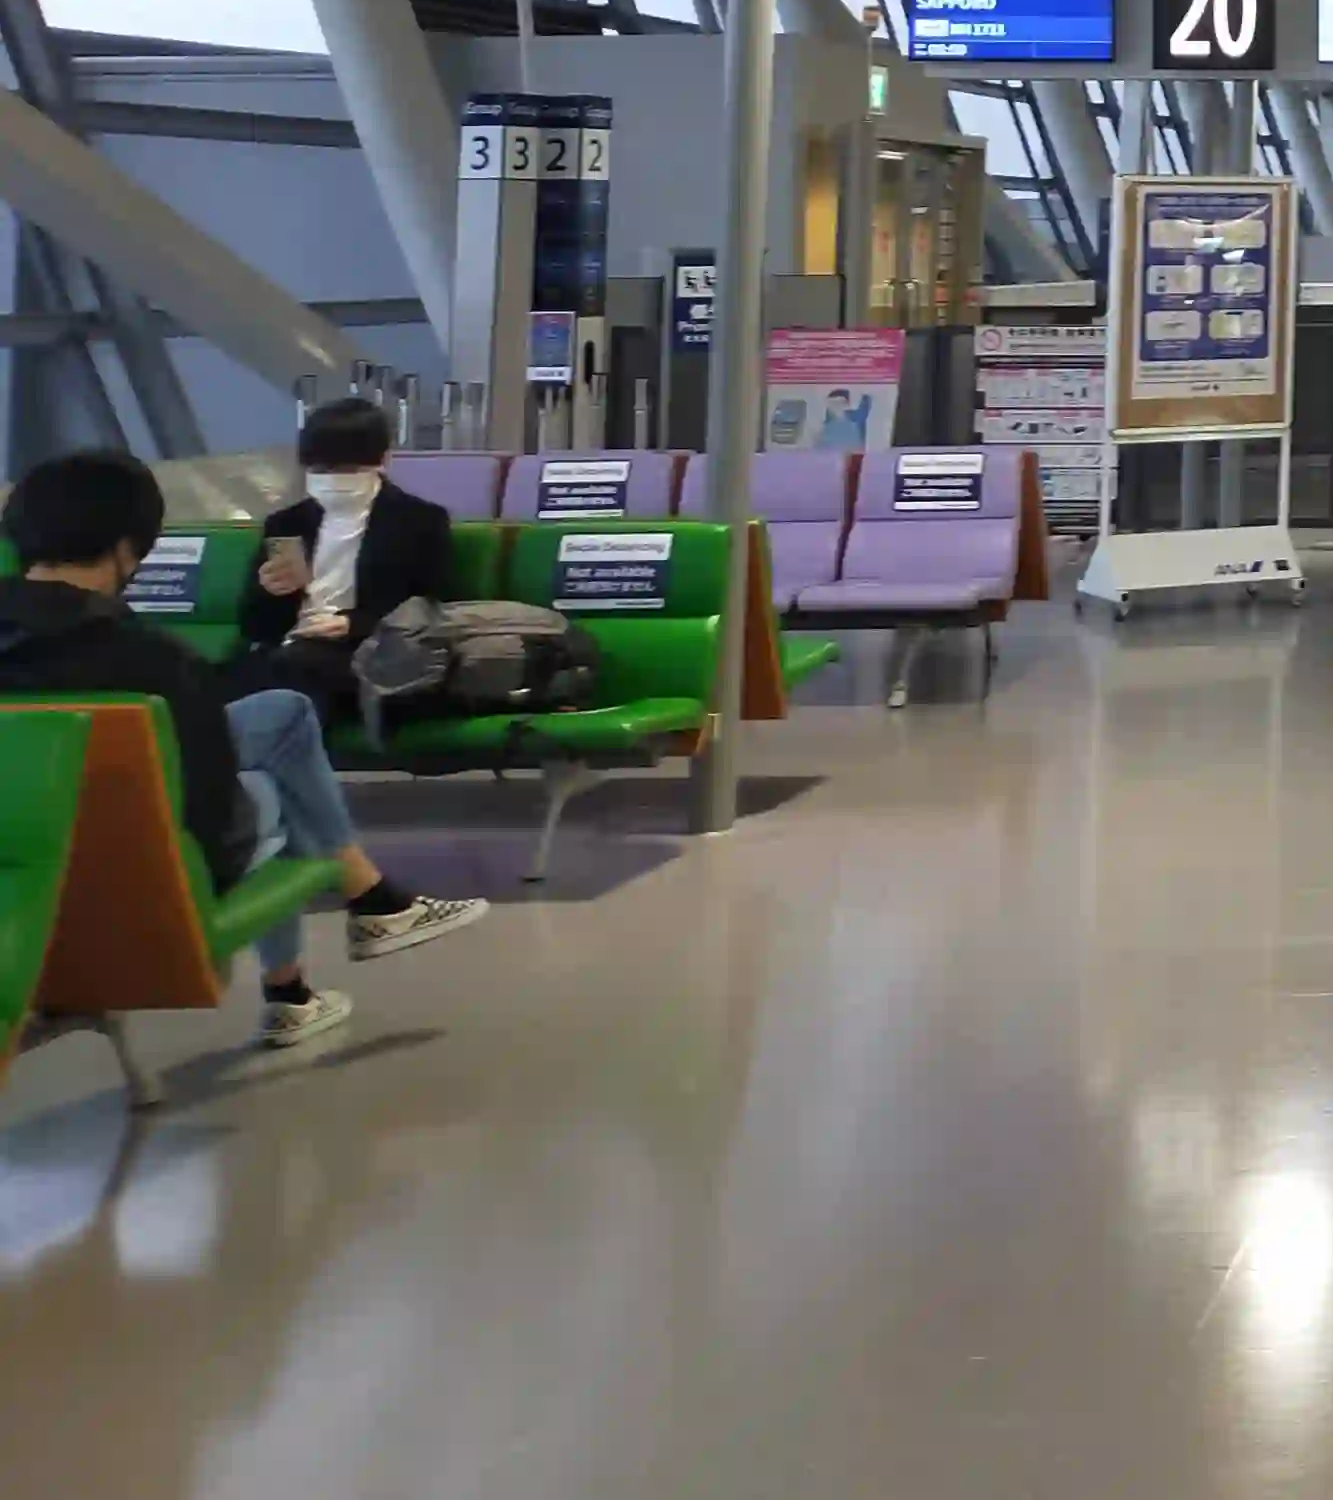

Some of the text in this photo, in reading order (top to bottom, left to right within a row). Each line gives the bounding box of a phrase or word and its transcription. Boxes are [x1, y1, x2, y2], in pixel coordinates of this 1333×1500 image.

[470, 136, 490, 170] 3
[512, 136, 530, 171] 3
[546, 138, 568, 172] 2
[588, 139, 602, 172] 2
